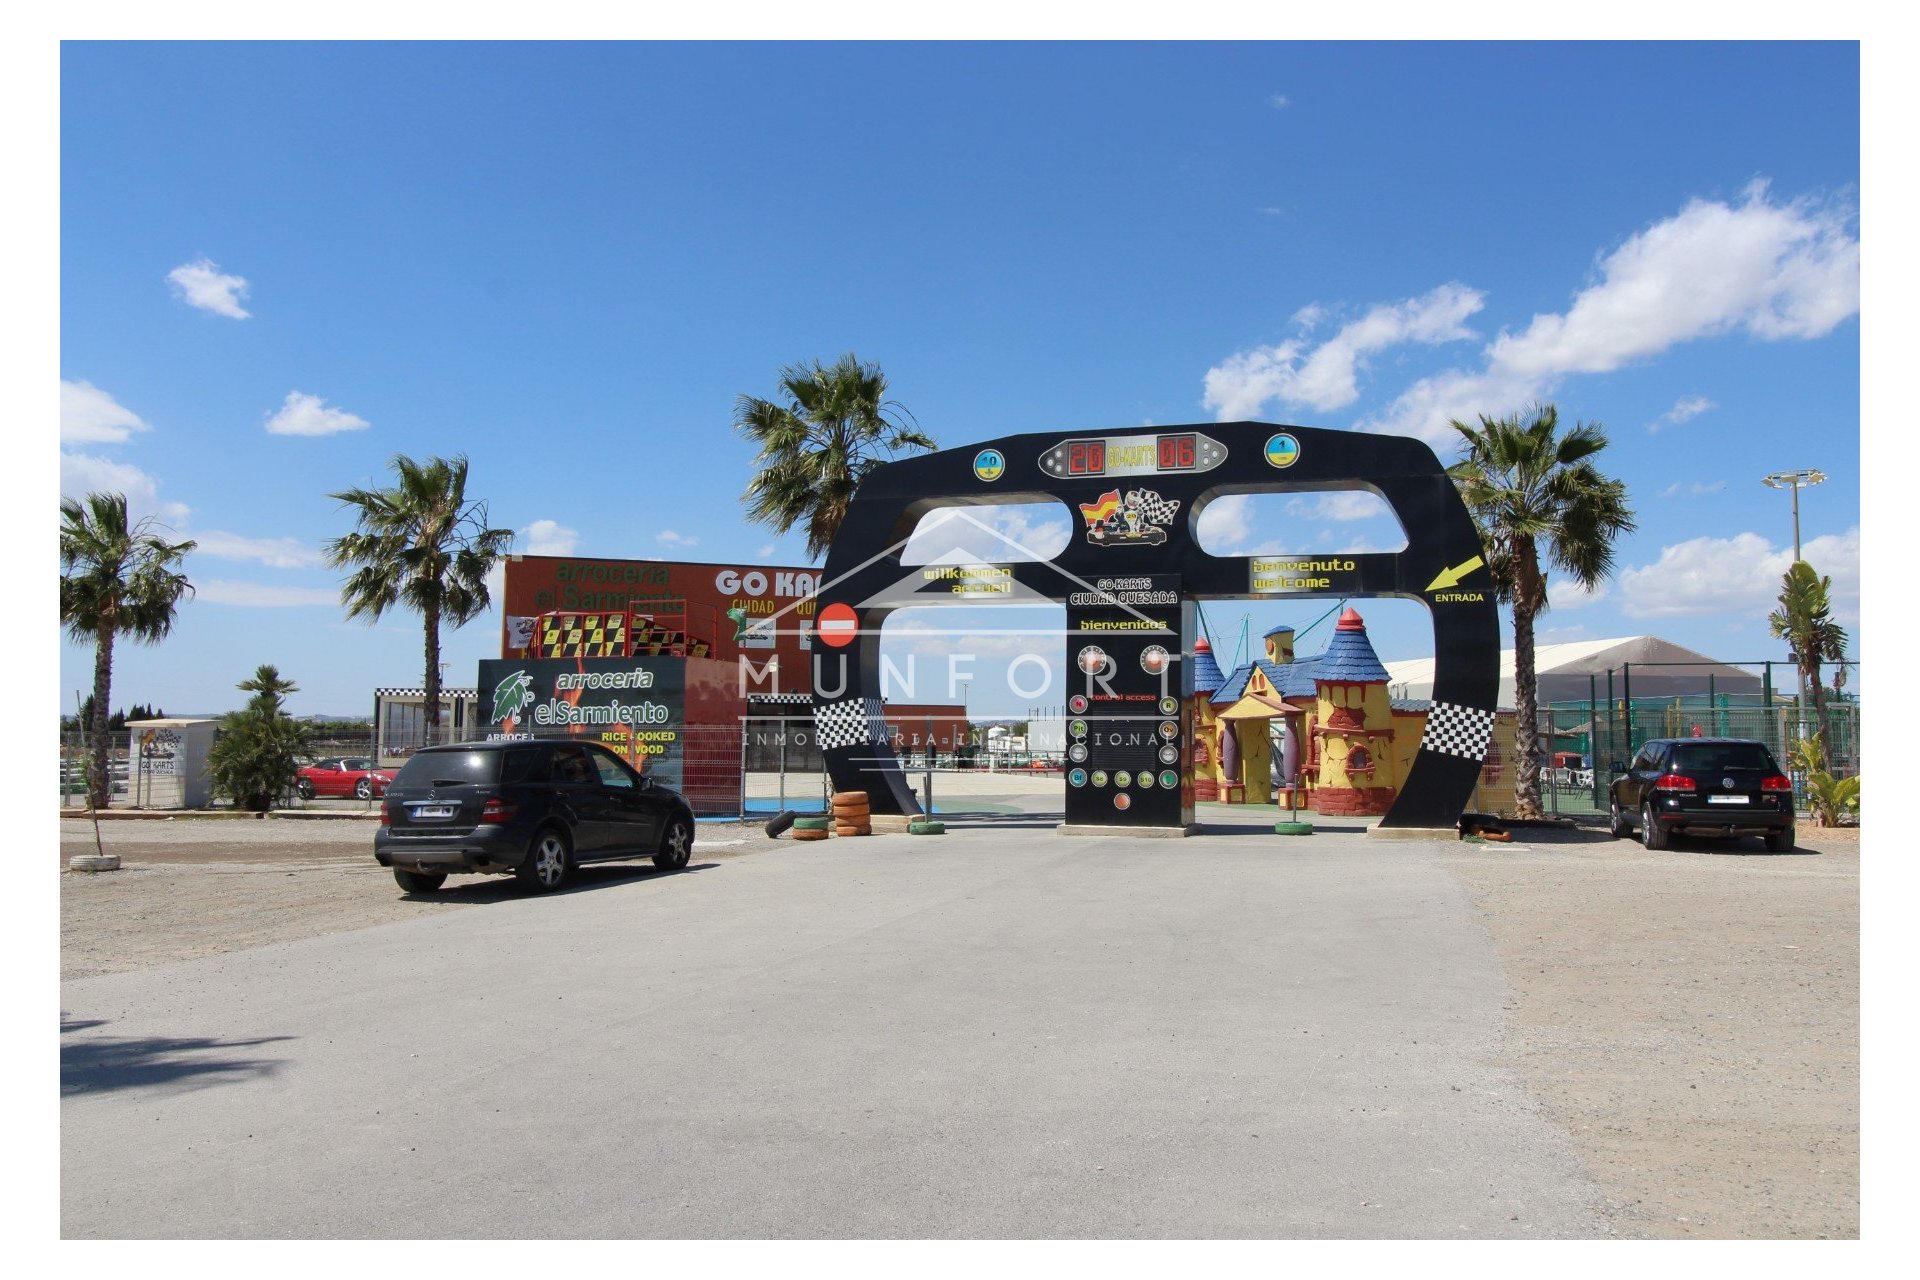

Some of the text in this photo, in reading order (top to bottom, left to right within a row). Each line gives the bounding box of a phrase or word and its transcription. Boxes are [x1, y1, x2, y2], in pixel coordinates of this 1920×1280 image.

[981, 456, 997, 466] 10
[1070, 437, 1195, 473] 20 GO-KARTS 06
[1253, 558, 1355, 573] benvenuto
[923, 567, 1012, 580] willkommen
[715, 570, 769, 597] GO
[952, 581, 1011, 594] accueil
[1098, 578, 1152, 590] GO-KARTS
[1254, 576, 1330, 589] welcome
[535, 585, 685, 612] el Sarmiento
[1070, 591, 1178, 605] CIUDAD QUESADA
[1435, 593, 1484, 602] ENTRADA
[732, 599, 816, 615] CIUDAD QU
[1080, 620, 1167, 630] bienvenidos
[1126, 693, 1156, 701] access
[602, 732, 627, 741] RICE
[613, 745, 628, 754] ON
